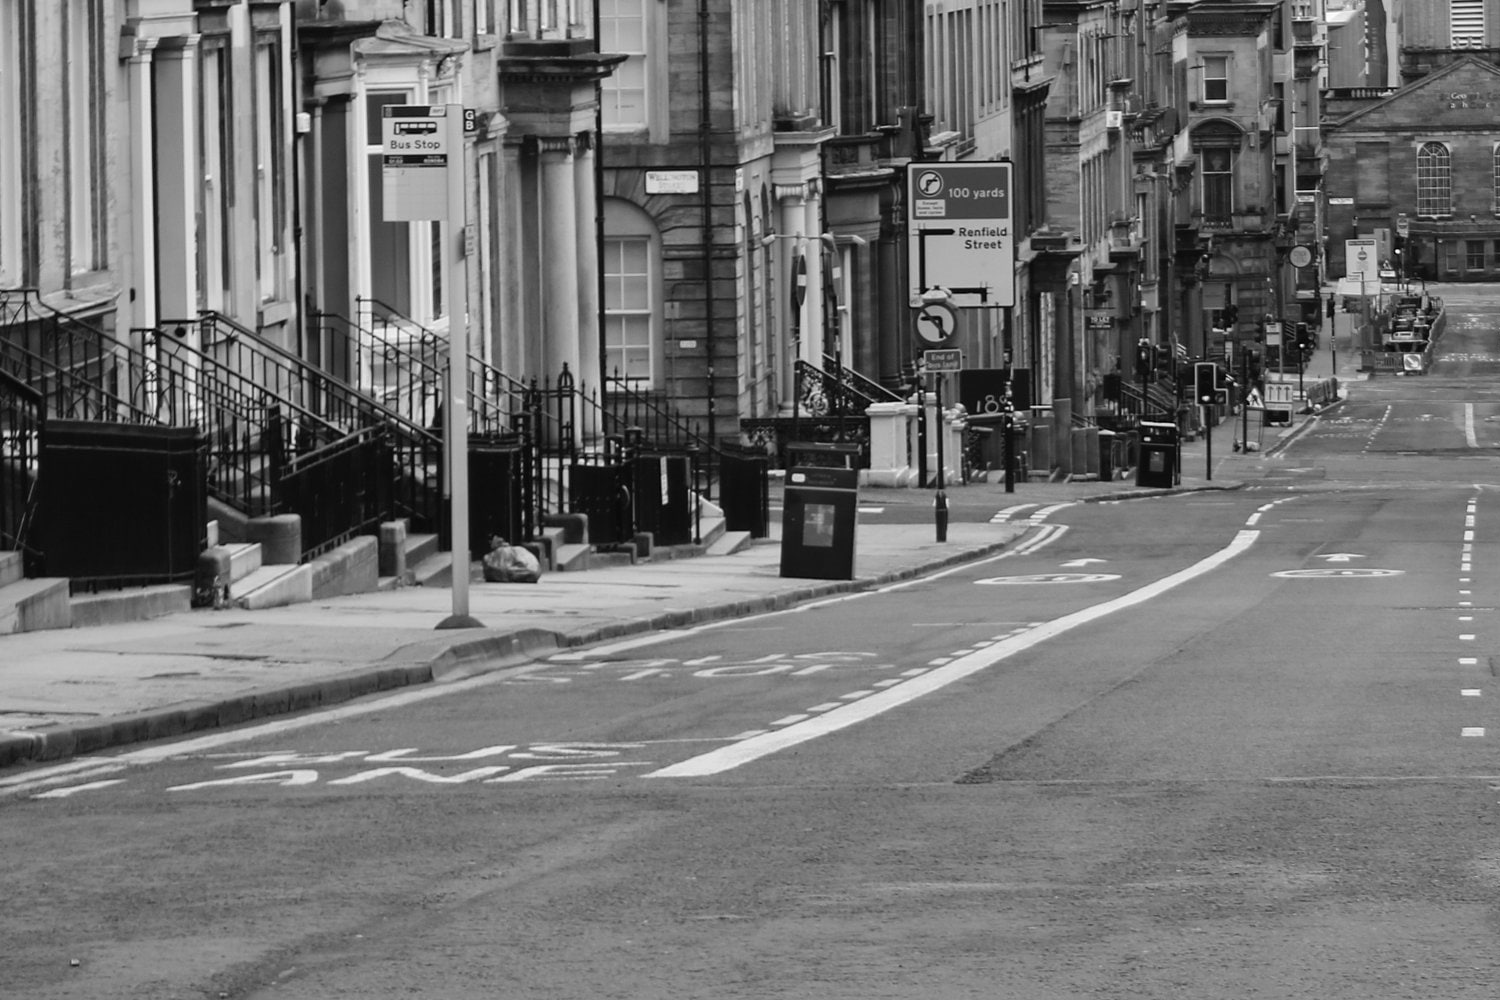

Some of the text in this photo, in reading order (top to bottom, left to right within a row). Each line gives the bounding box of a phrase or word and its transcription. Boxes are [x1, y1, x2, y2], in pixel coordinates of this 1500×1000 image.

[390, 140, 441, 151] Bus Stop
[948, 187, 1005, 199] 100 yards
[959, 227, 1007, 237] Renfield
[964, 239, 1002, 249] Street
